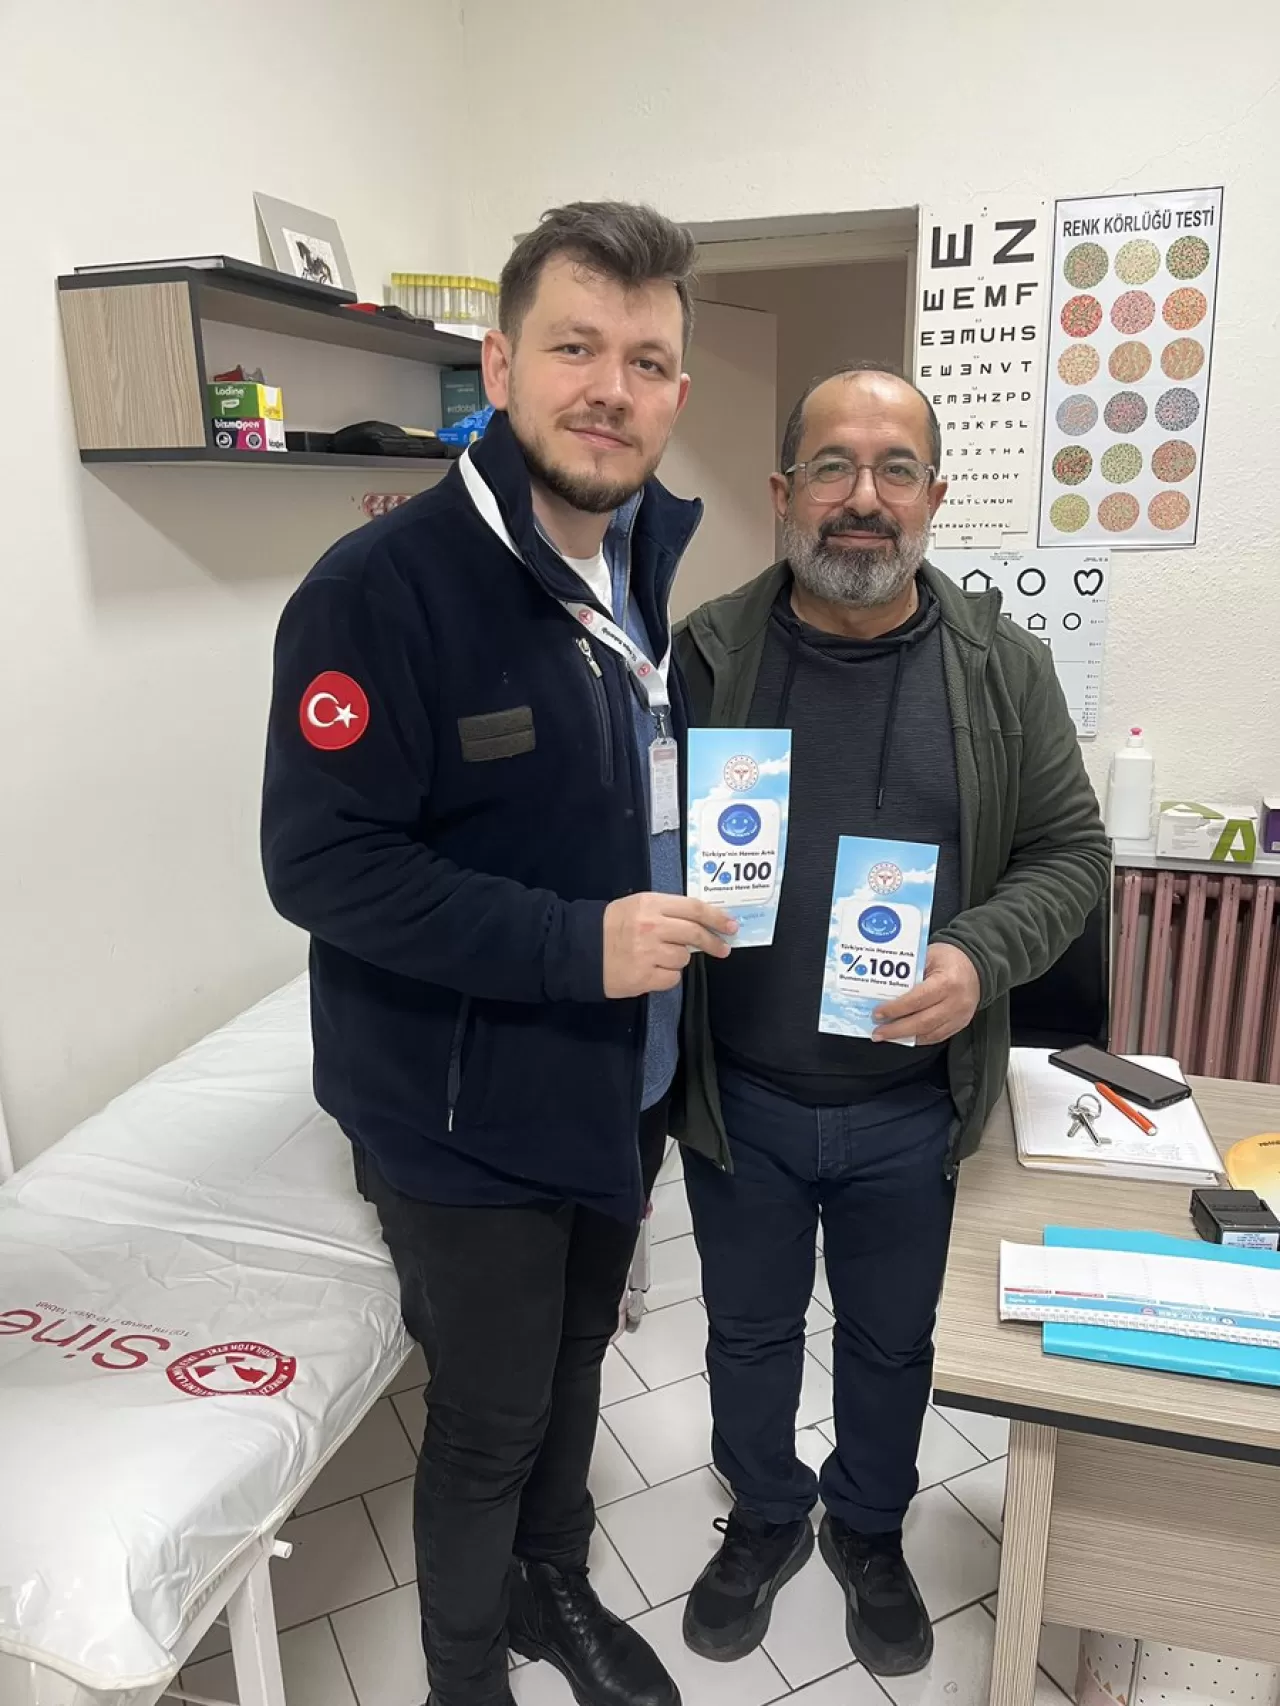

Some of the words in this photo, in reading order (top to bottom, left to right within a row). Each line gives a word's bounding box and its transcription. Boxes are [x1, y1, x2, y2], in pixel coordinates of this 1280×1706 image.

[1063, 218, 1100, 237] RENK
[1103, 209, 1172, 234] KÖRLÜĞÜ
[1175, 205, 1215, 229] TESTİ
[703, 861, 772, 884] %100
[840, 951, 911, 979] %100
